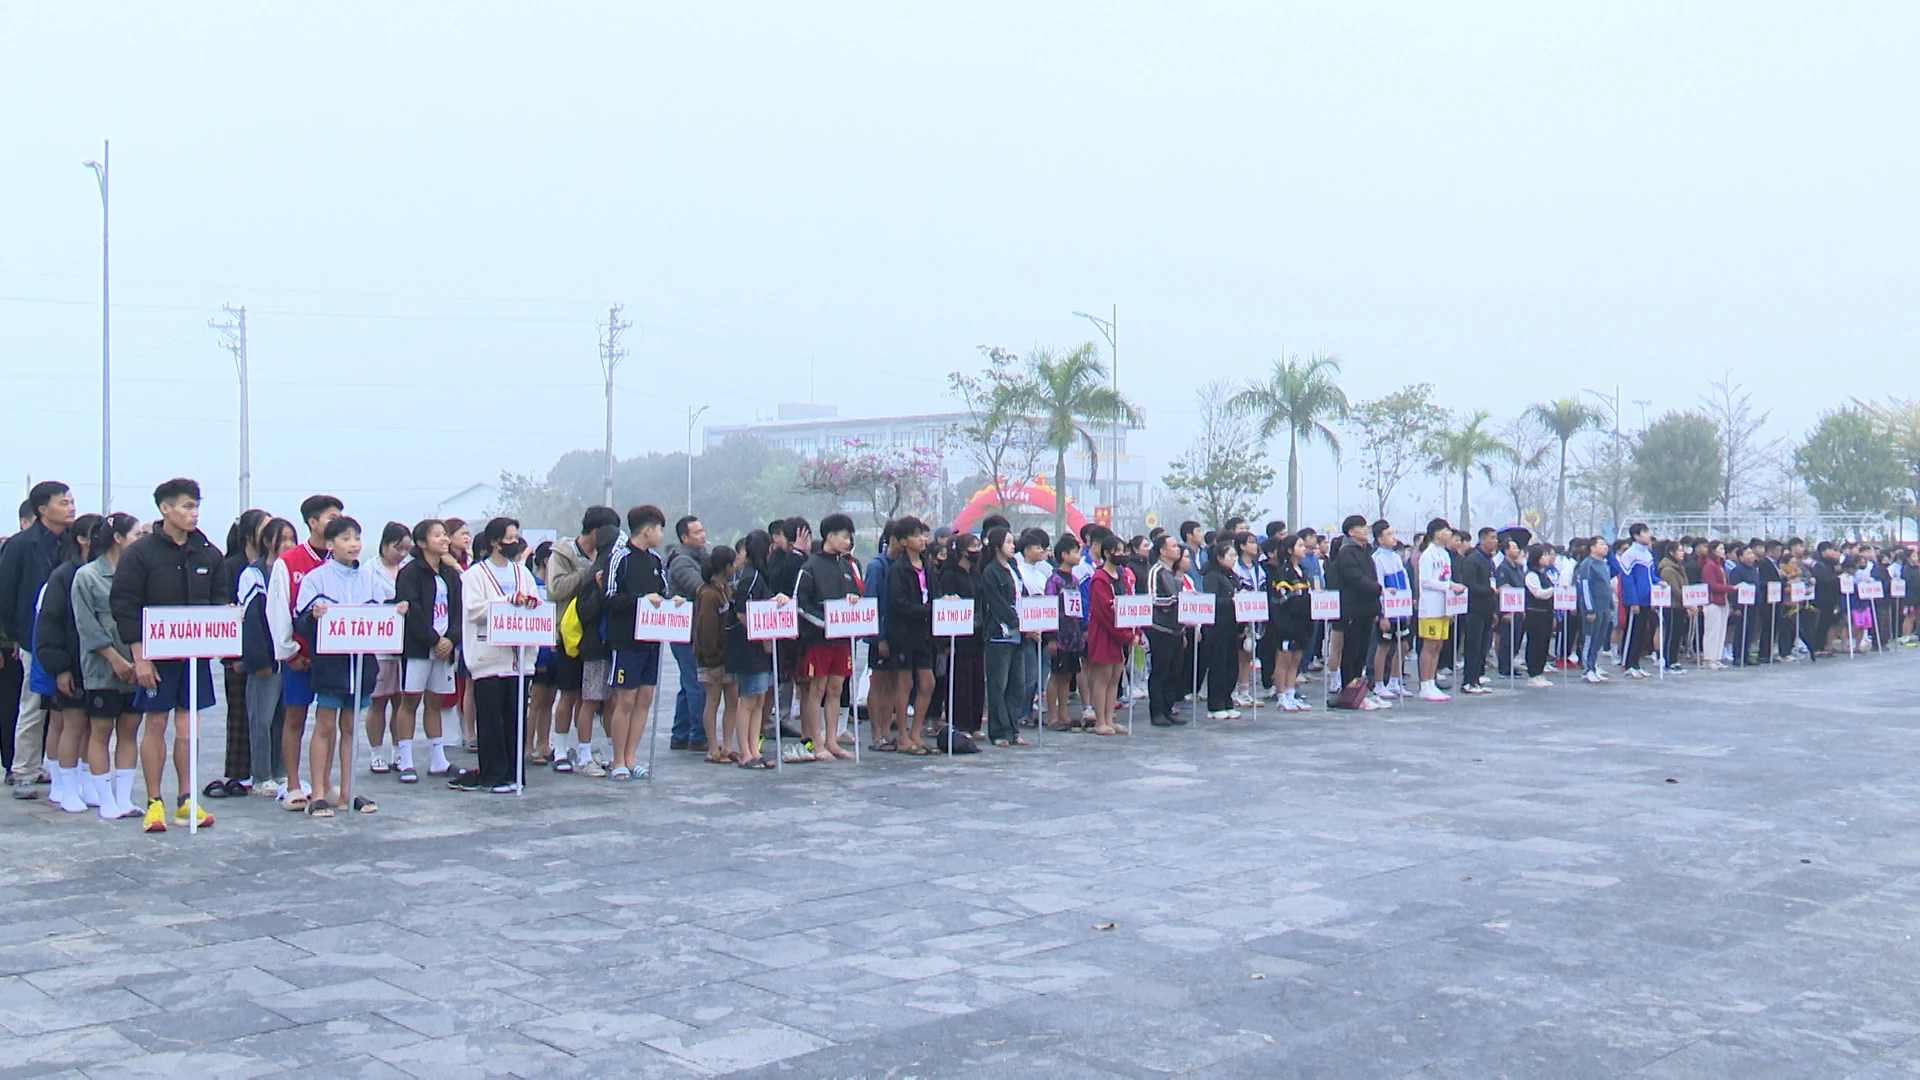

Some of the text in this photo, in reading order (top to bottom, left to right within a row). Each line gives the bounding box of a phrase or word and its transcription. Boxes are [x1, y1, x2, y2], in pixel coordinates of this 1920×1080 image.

[1069, 599, 1080, 612] 75
[150, 620, 237, 639] XÃ XUÂN HƯNG
[329, 615, 395, 637] XÃ TÂY HỒ
[617, 668, 625, 685] 6
